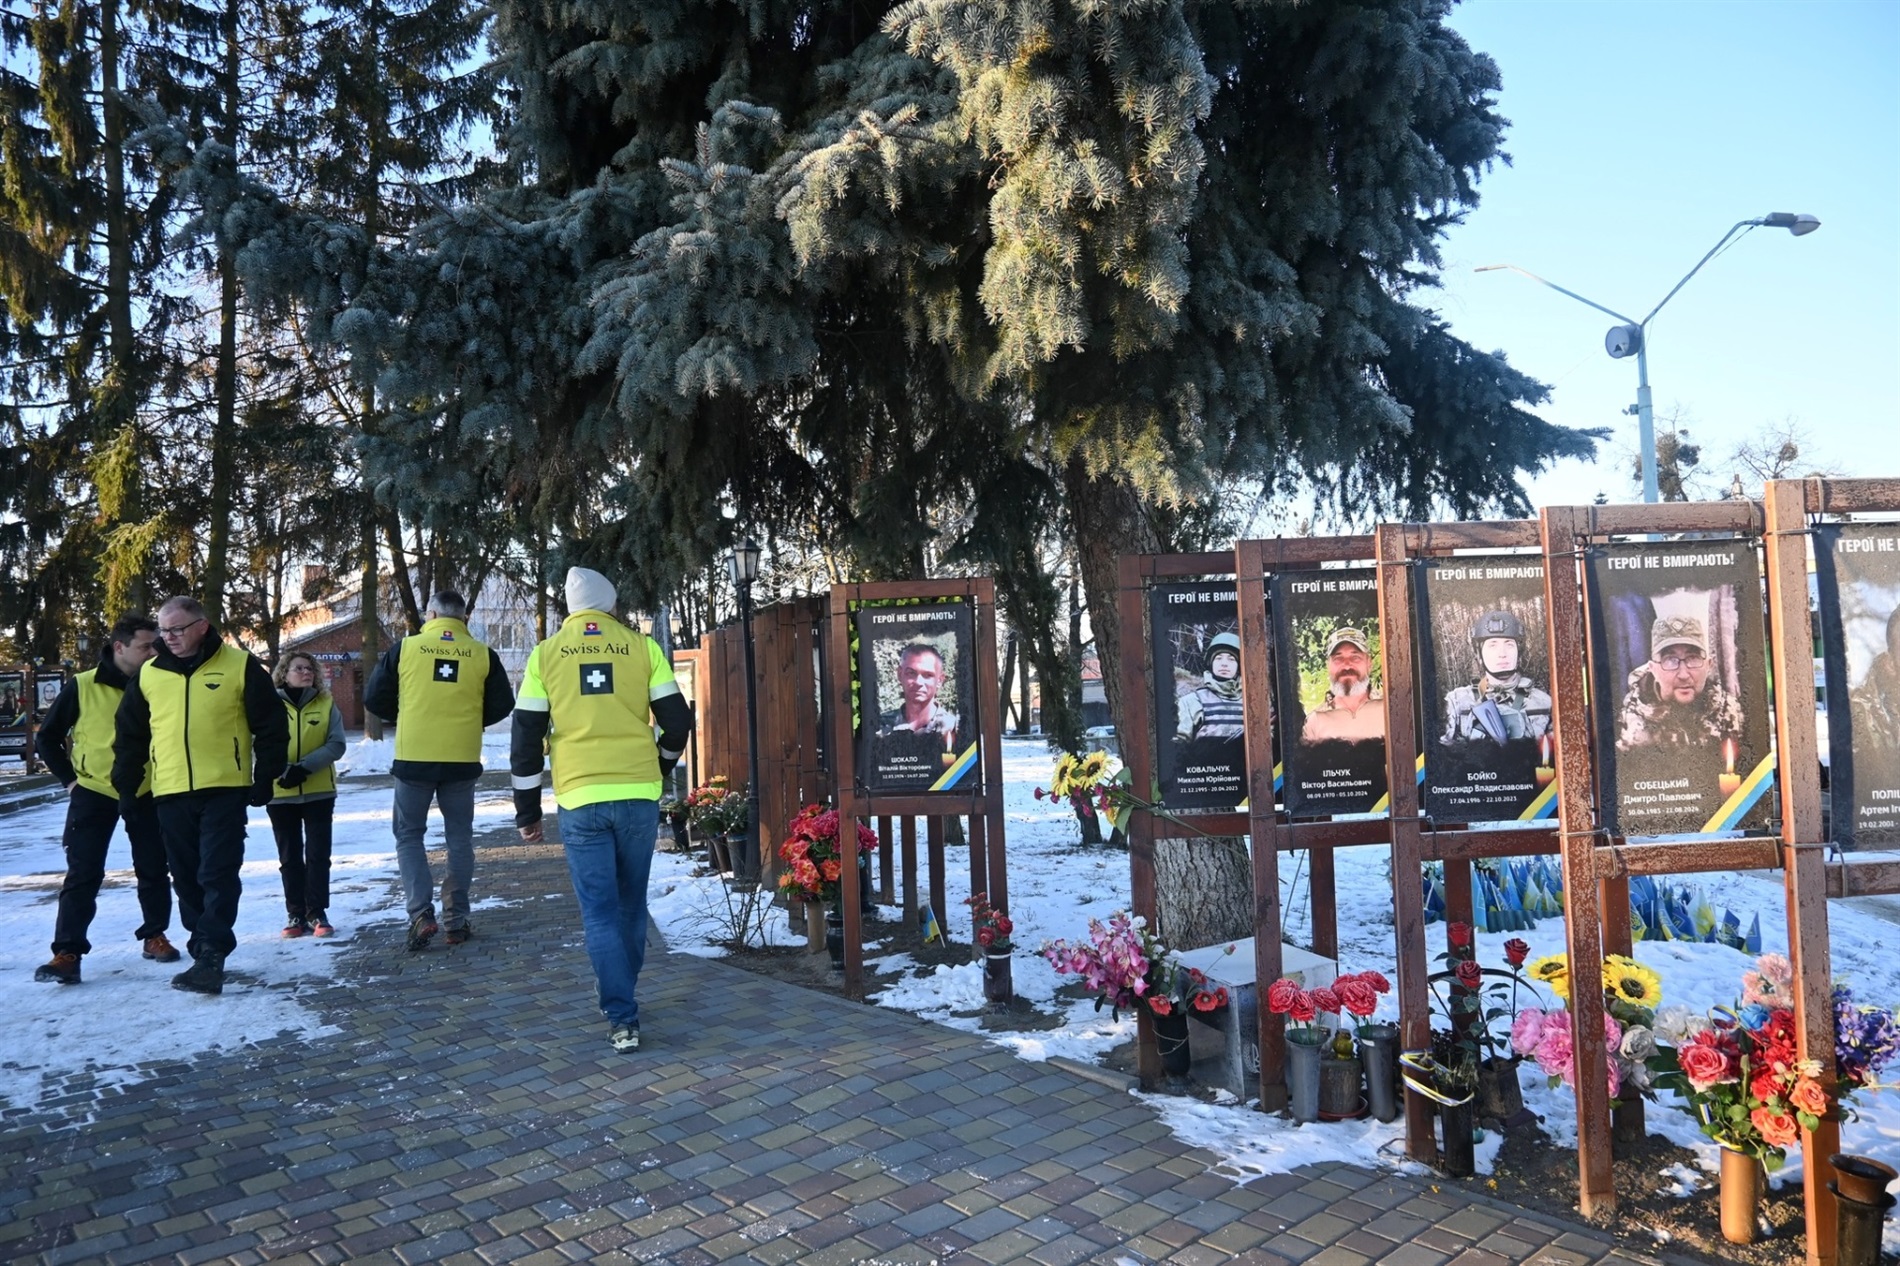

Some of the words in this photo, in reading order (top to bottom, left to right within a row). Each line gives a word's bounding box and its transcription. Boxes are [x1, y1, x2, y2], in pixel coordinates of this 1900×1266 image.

[1838, 536, 1875, 553] ГЕРОЇ
[1877, 538, 1894, 552] НЕ
[1608, 554, 1642, 570] ГЕРОЇ
[1644, 556, 1660, 568] НЕ
[1662, 553, 1735, 568] ВМИРАЮТЬ!
[1435, 566, 1467, 580] ГЕРОЇ
[1469, 568, 1483, 579] НЕ
[1291, 580, 1321, 593] ГЕРОЇ
[1323, 581, 1337, 592] НЕ
[1168, 591, 1196, 604] ГЕРОЇ
[1198, 592, 1211, 603] НЕ
[872, 613, 895, 624] ГЕРОЇ
[896, 614, 907, 622] НЕ
[908, 611, 956, 622] ВМИРАЮТЬ!
[420, 645, 450, 656] Swiss
[452, 647, 472, 658] Aid
[560, 642, 600, 659] Swiss
[603, 642, 630, 656] Aid
[878, 764, 898, 772] Віталій
[900, 764, 932, 772] Вікторович
[1186, 765, 1231, 774] КОВАЛЬЧУК
[1322, 768, 1351, 777] ІЛЬЧУК
[1205, 775, 1241, 784] Юрійович
[1467, 771, 1497, 781] БОЙКО
[1301, 781, 1326, 789] Віктор
[1327, 779, 1372, 788] Васильович
[1431, 785, 1474, 794] Олександр
[1474, 783, 1534, 793] Владиславович
[1633, 778, 1689, 790] СОБЕЦЬКИЙ
[1623, 795, 1658, 805] Дмитро
[1658, 793, 1702, 802] Павлович
[1860, 805, 1890, 817] Артем
